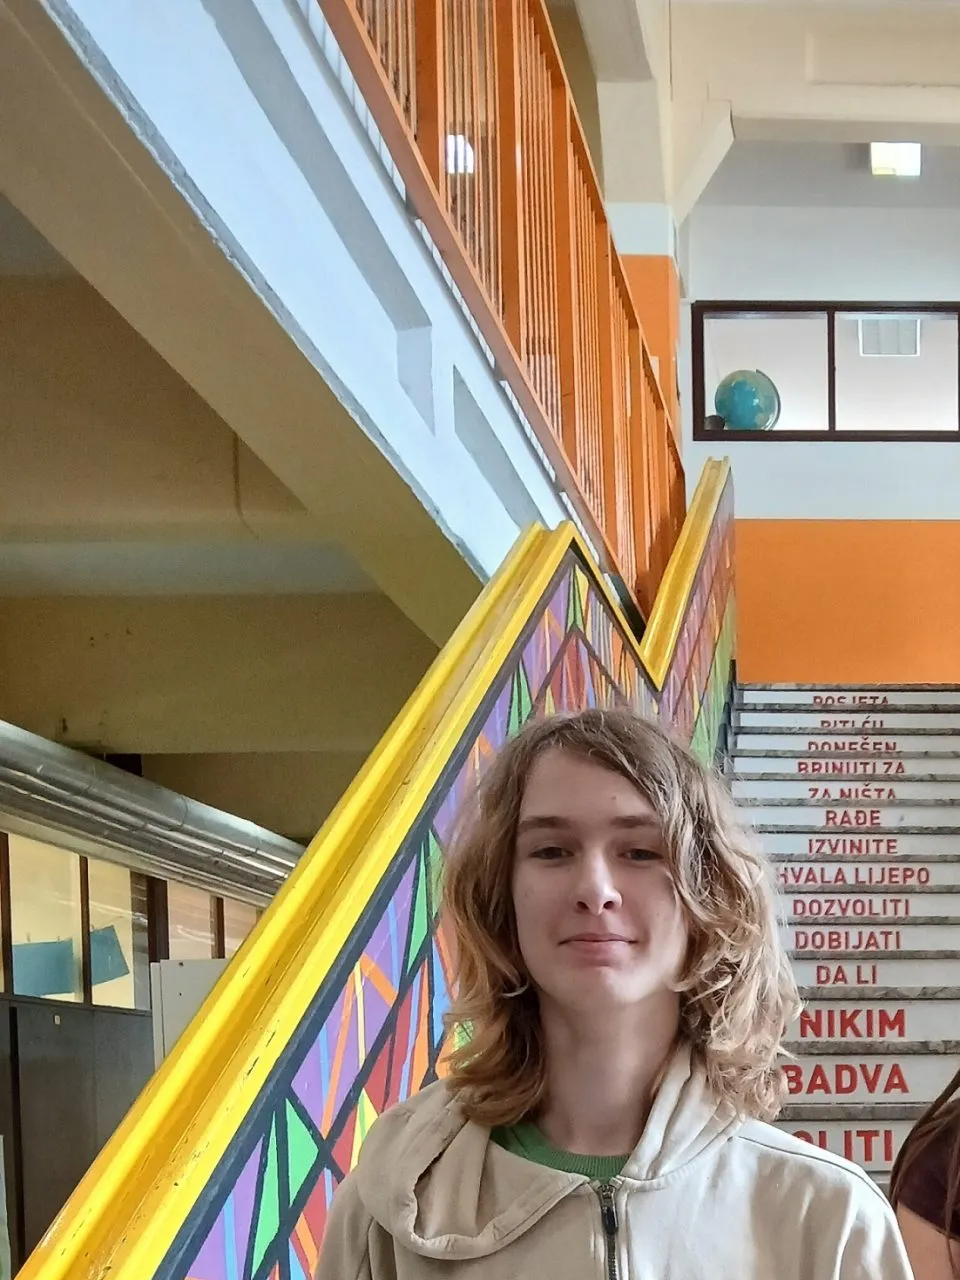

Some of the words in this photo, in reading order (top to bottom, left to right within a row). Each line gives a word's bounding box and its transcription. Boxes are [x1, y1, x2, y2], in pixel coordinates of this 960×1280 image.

[825, 809, 881, 826] RAĐE
[808, 838, 898, 855] IZVINITE
[854, 866, 931, 884] LIJEPO
[793, 898, 910, 916] DOZVOLITI
[794, 930, 901, 950] DOBIJATI
[816, 965, 848, 985] DA
[856, 965, 877, 985] LI
[800, 1009, 905, 1037] NIKIM
